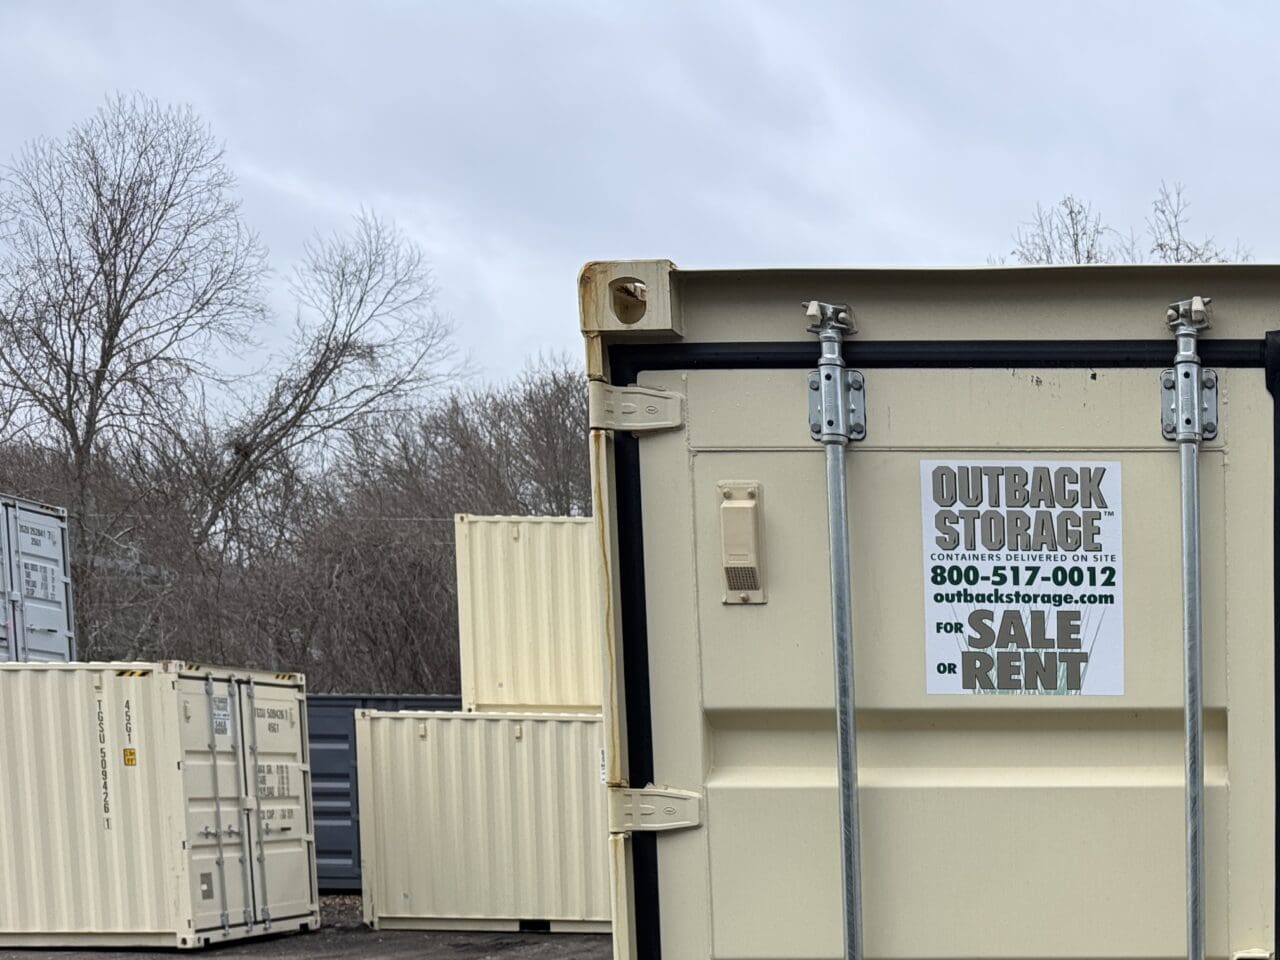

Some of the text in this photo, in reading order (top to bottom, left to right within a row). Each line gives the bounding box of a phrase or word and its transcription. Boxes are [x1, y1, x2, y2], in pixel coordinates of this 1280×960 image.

[932, 466, 1108, 508] OUTBACK
[934, 509, 1103, 551] STORAGE
[931, 553, 1117, 562] CONTAINERS DELIVERED ON SITE
[931, 565, 1116, 586] 800-517-0012
[934, 589, 1114, 606] outbackstorage.com
[936, 609, 1081, 649] FOR SALE
[937, 651, 1088, 690] OR RENT
